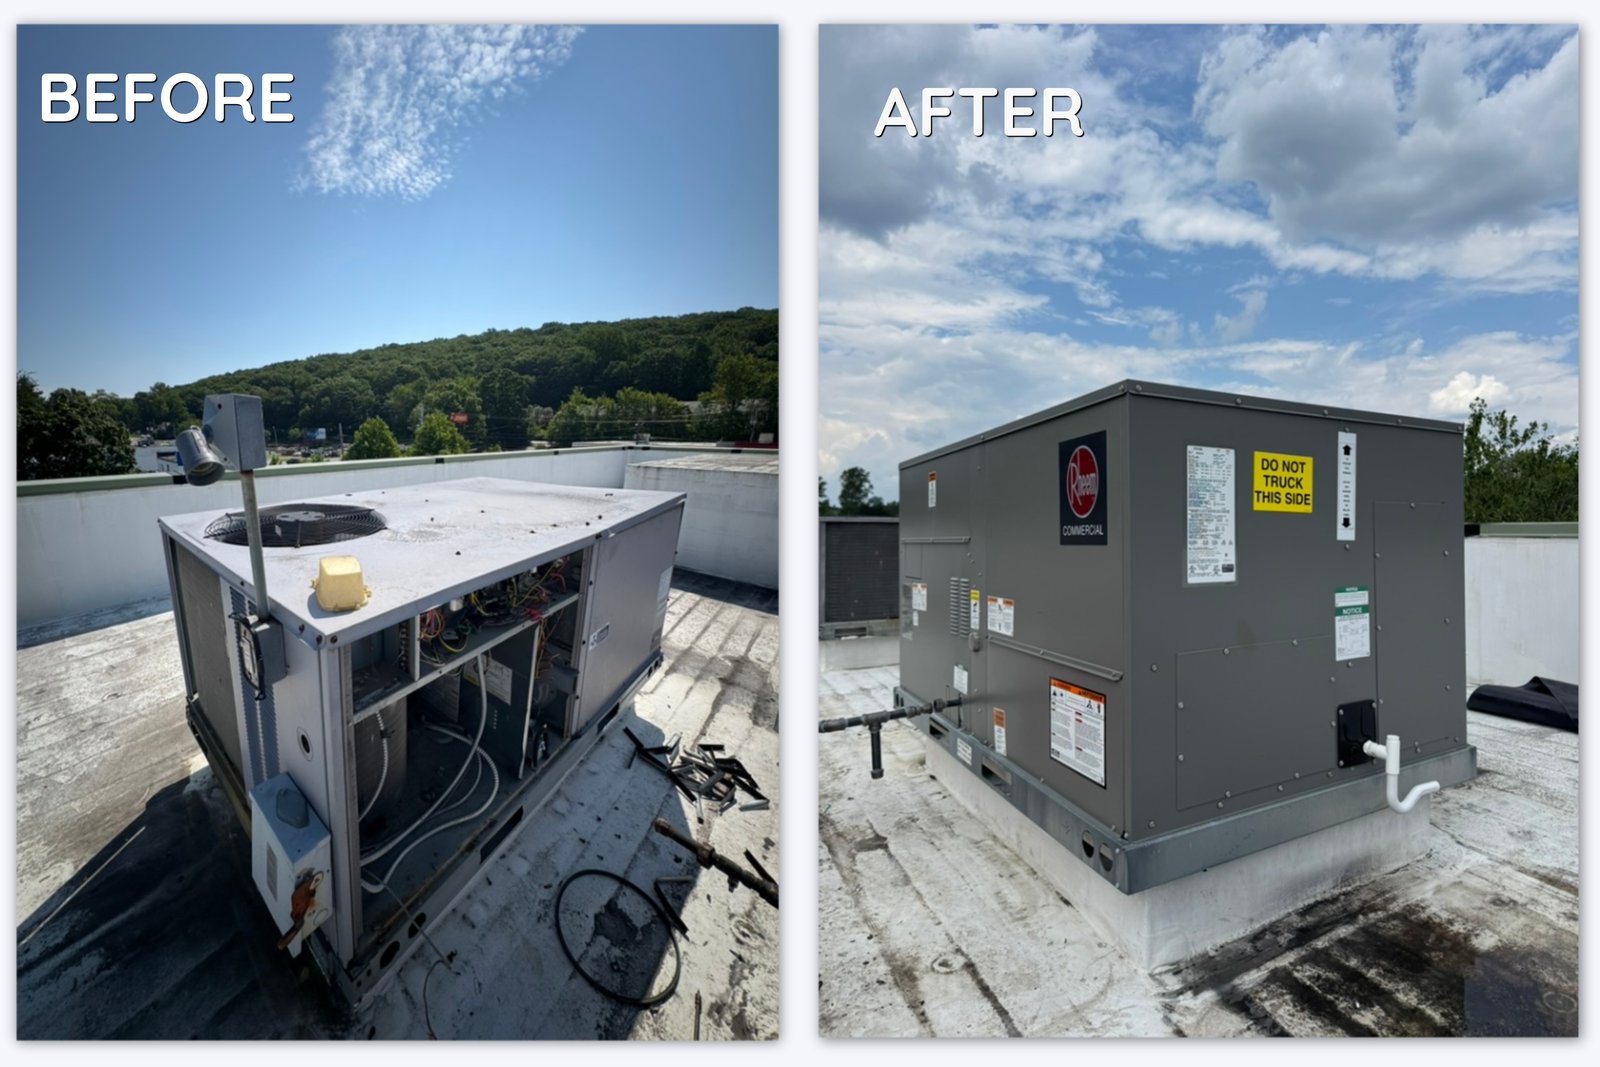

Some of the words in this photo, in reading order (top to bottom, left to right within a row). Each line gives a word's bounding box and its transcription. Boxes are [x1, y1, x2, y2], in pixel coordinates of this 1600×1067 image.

[1261, 458, 1279, 471] DO
[1282, 460, 1306, 474] NOT
[1068, 449, 1097, 506] Rheem
[1263, 474, 1303, 489] TRUCK
[1255, 490, 1282, 504] THIS
[1284, 492, 1311, 506] SIDE
[1062, 524, 1104, 536] COMMERCIAL
